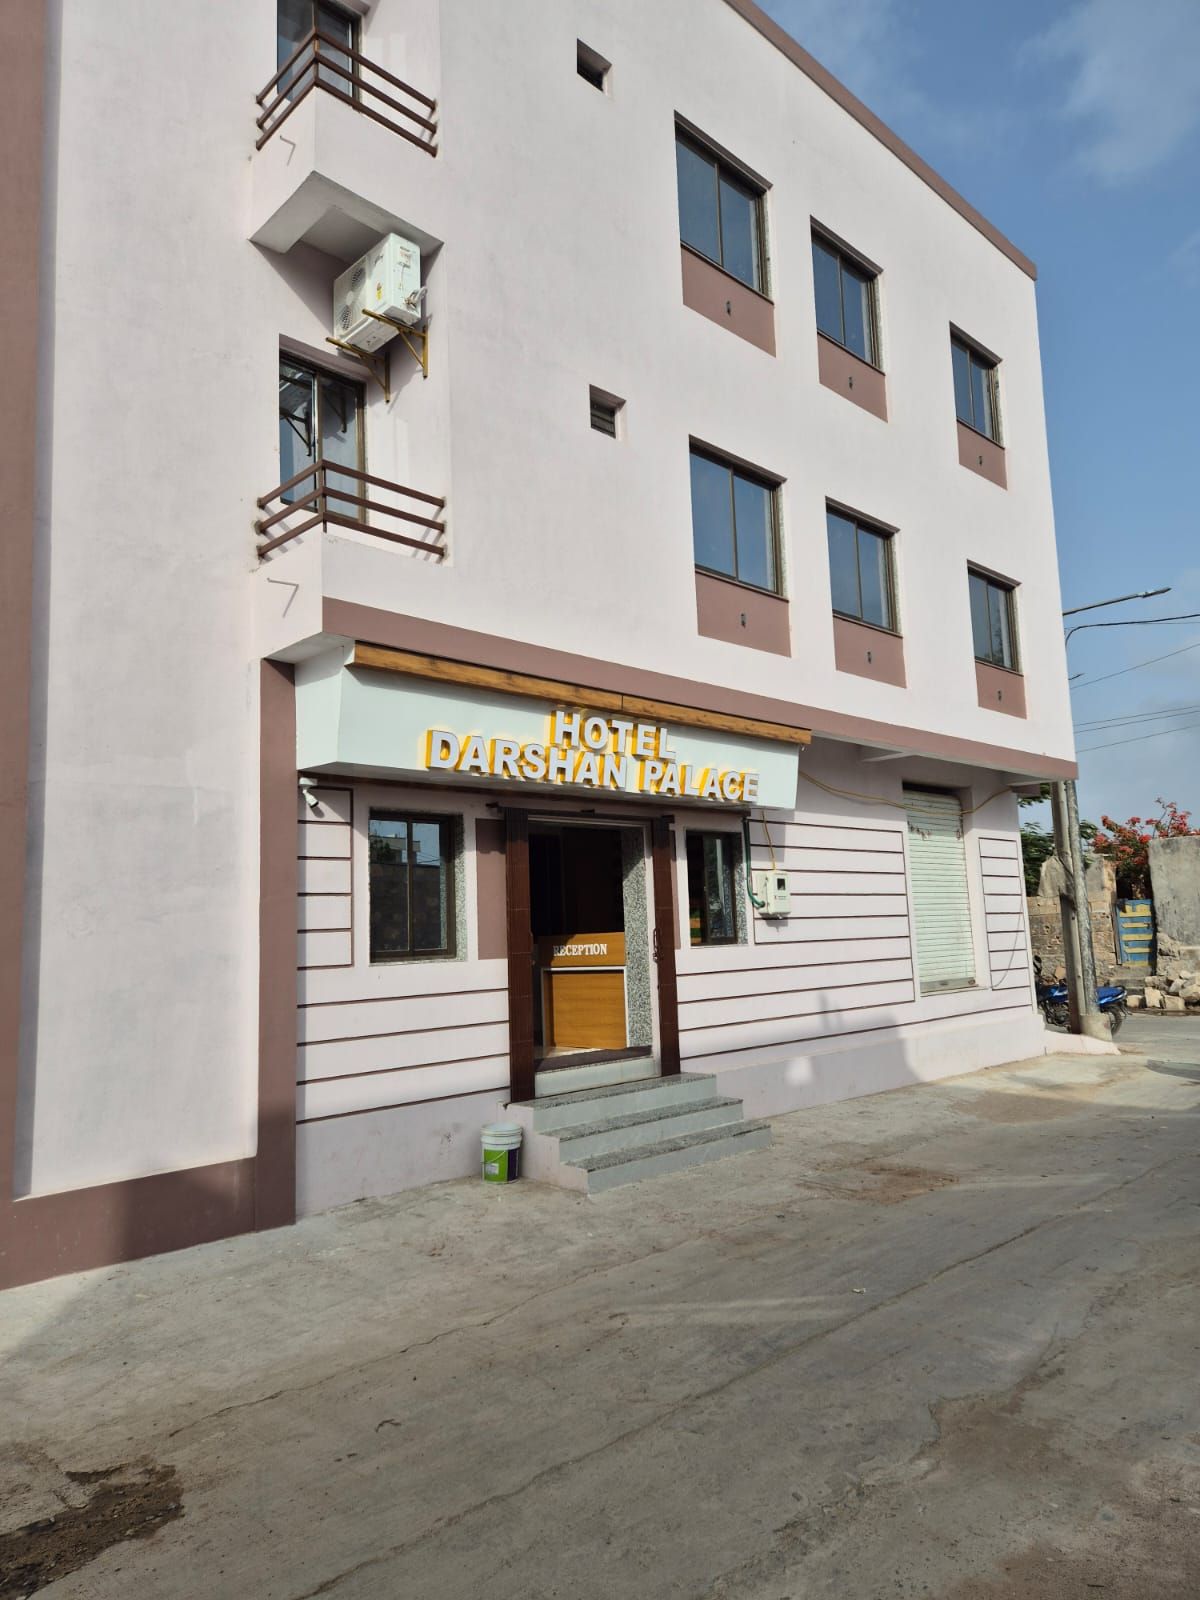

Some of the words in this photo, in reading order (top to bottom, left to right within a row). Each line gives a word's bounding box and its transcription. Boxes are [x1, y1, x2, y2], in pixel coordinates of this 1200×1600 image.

[550, 709, 677, 760] HOTEL
[427, 729, 628, 790] DARSHAN
[639, 759, 761, 802] PALACE
[553, 943, 608, 957] RECEPTION
